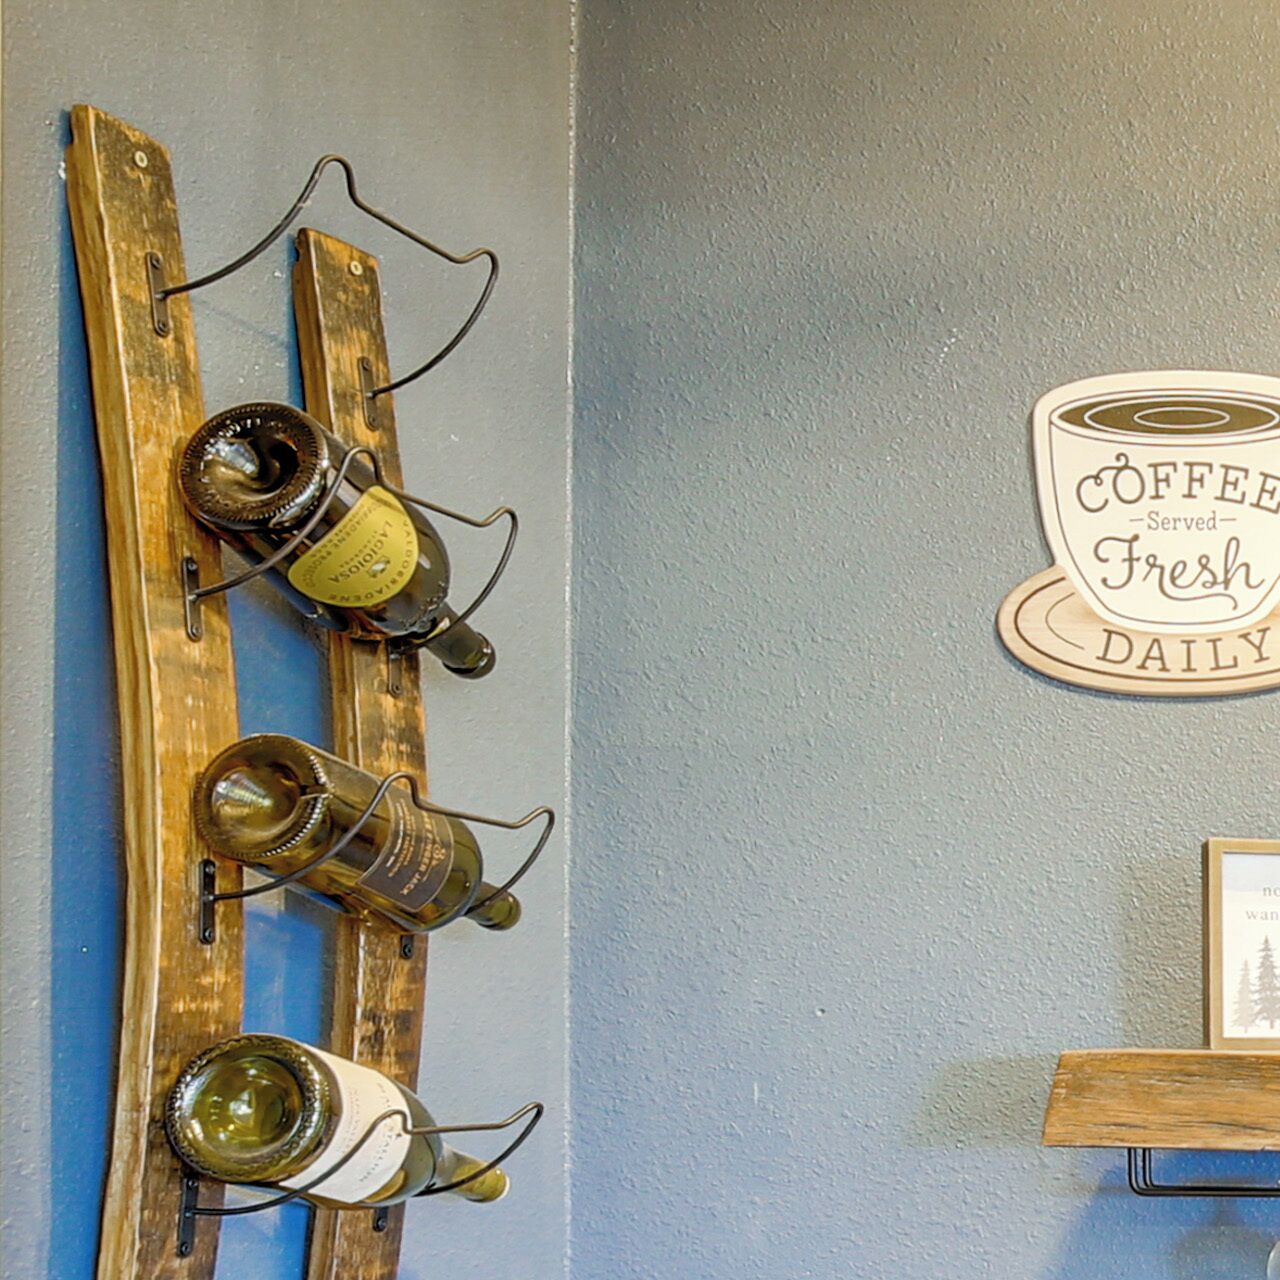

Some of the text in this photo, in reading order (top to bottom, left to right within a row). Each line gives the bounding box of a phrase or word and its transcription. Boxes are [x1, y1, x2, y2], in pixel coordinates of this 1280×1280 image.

[1146, 510, 1218, 531] Served
[1093, 534, 1265, 610] Fresh
[1095, 627, 1272, 673] DAILY
